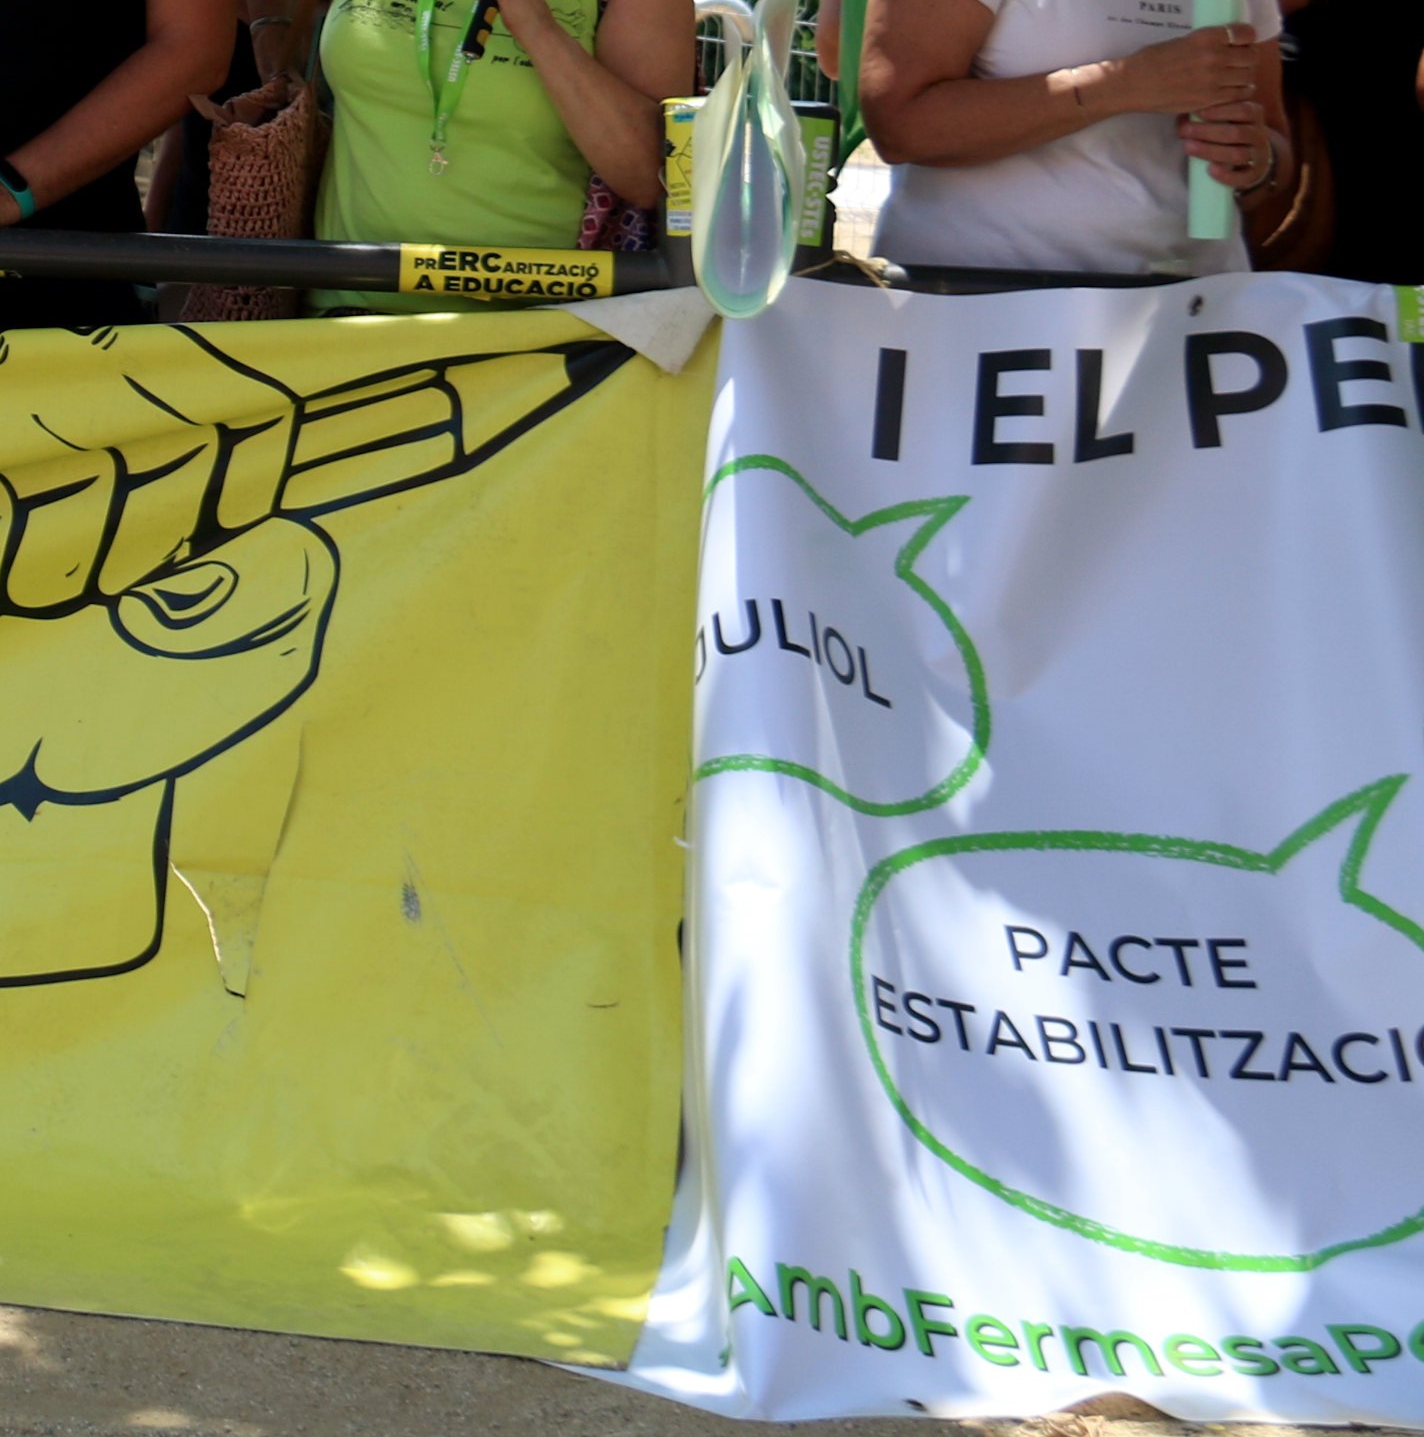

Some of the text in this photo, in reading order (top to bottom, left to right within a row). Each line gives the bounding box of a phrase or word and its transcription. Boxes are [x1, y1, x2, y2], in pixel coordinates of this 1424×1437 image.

[414, 274, 598, 298] A EDUCACIÓ
[871, 316, 1424, 465] I EL PE
[1004, 925, 1259, 991] PACTE
[871, 974, 1424, 1085] ESTABILITZACI
